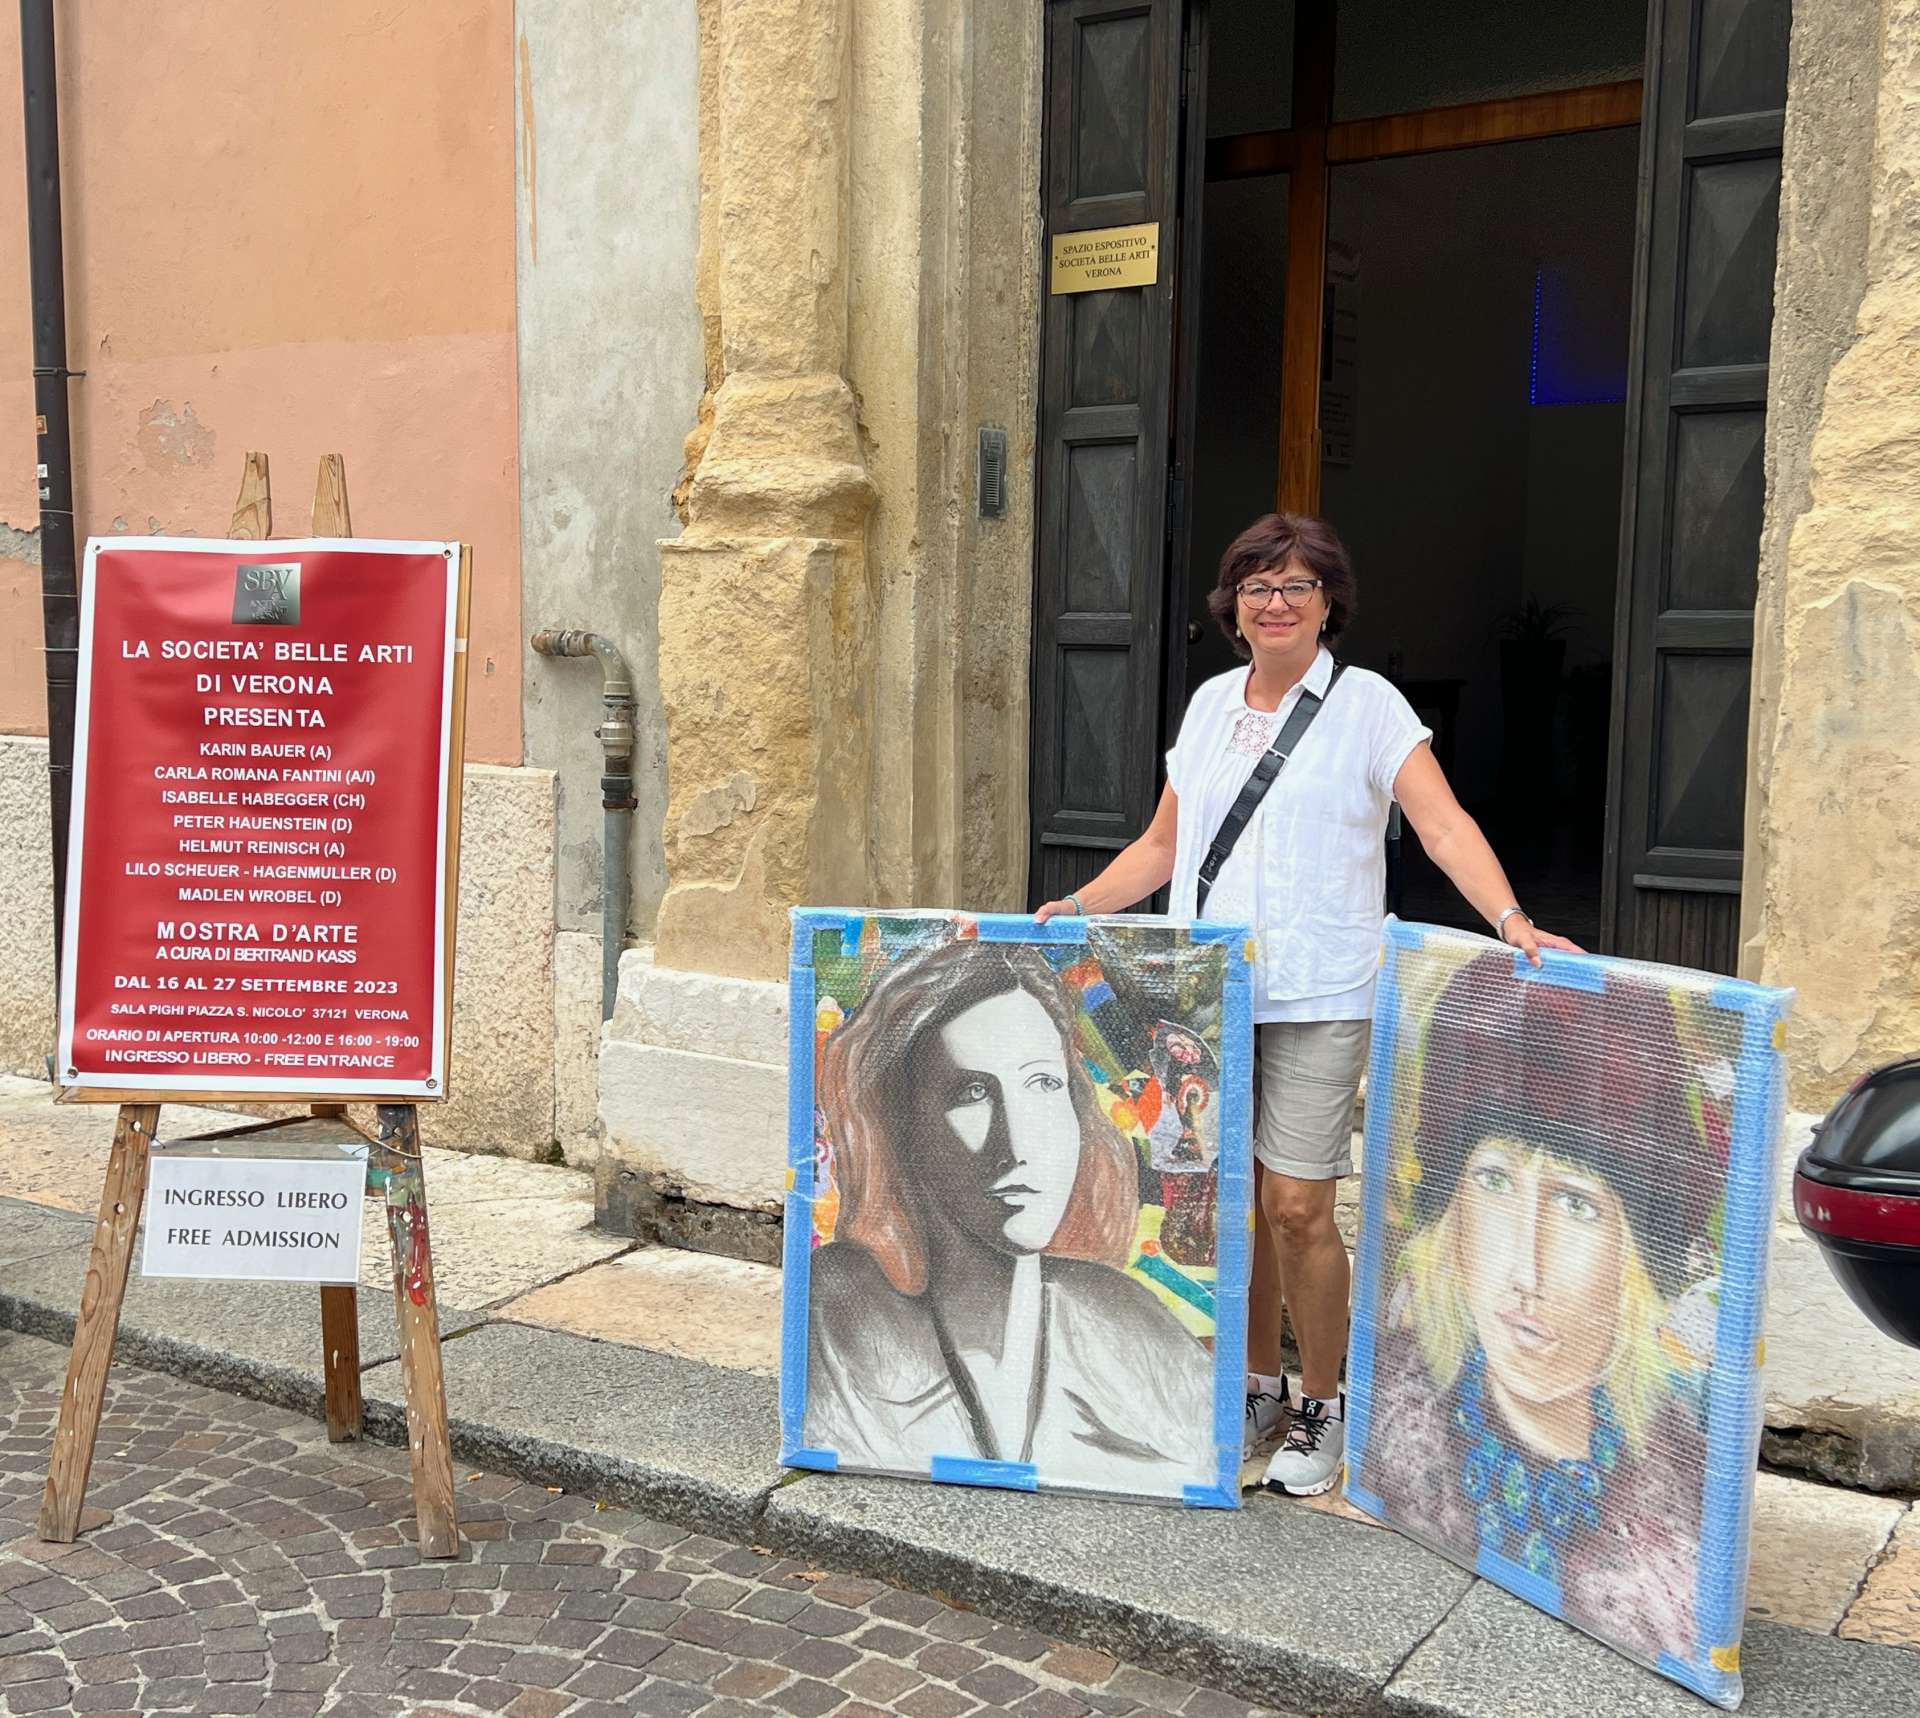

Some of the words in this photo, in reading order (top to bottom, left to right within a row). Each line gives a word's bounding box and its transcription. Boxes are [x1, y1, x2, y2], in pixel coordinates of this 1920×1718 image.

[1063, 243, 1093, 255] SPAZIO
[1095, 237, 1147, 251] ESPOSITIVO
[1098, 252, 1127, 264] BELLE
[1128, 249, 1150, 260] ARTI
[1085, 267, 1122, 278] VERONA
[122, 640, 150, 659] LA
[274, 642, 348, 662] BELLE
[358, 644, 413, 664] ARTI
[196, 673, 221, 693] DI
[231, 674, 334, 695] VERONA
[204, 707, 326, 728] PRESENTA
[200, 742, 246, 757] KARIN
[250, 744, 306, 758] BAUER
[309, 745, 332, 761] (A)
[154, 766, 208, 780] CARLA
[211, 767, 279, 782] ROMANA
[282, 768, 342, 783] FANTINI
[345, 769, 376, 786] (A/I)
[162, 790, 238, 805] ISABELLE
[242, 792, 329, 807] HABEGGER
[333, 793, 366, 810] (CH)
[173, 814, 225, 829] PETER
[228, 816, 328, 831] HAUENSTEIN
[331, 817, 353, 834] (D)
[179, 839, 244, 854] HELMUT
[247, 841, 320, 856] REINISCH
[323, 842, 345, 858] (A)
[125, 862, 161, 876] LILO
[163, 863, 240, 878] SCHEUER
[252, 865, 372, 881] HAGENMULLER
[375, 867, 397, 884] (D)
[178, 887, 245, 902] MADLEN
[248, 889, 317, 904] WROBEL
[320, 890, 342, 907] (D)
[157, 921, 260, 942] MOSTRA
[155, 946, 169, 960] A
[170, 945, 213, 961] CURA
[214, 947, 231, 961] DI
[233, 947, 314, 963] BERTRAND
[316, 949, 357, 964] KASS
[114, 975, 151, 990] DAL
[157, 976, 179, 991] 16
[183, 977, 208, 991] AL
[213, 977, 236, 992] 27
[240, 978, 348, 994] SETTEMBRE
[353, 980, 399, 995] 2023
[110, 1003, 147, 1016] SALA
[148, 1004, 185, 1017] PIGHI
[187, 1005, 235, 1018] PIAZZA
[236, 1006, 249, 1018] S.
[312, 1008, 348, 1020] 37121
[354, 1008, 409, 1021] VERONA
[86, 1027, 144, 1042] ORARIO
[145, 1030, 161, 1043] DI
[162, 1030, 241, 1044] APERTURA
[243, 1032, 279, 1046] 10:00
[324, 1034, 335, 1047] E
[338, 1034, 373, 1048] 16:00
[384, 1035, 420, 1049] 19:00
[104, 1049, 190, 1065] INGRESSO
[192, 1051, 252, 1066] LIBERO
[263, 1053, 305, 1067] FREE
[306, 1054, 395, 1069] ENTRANCE
[164, 1188, 265, 1208] INGRESSO
[277, 1191, 348, 1210] LIBERO
[167, 1228, 212, 1246] FREE
[222, 1229, 341, 1249] ADMISSION
